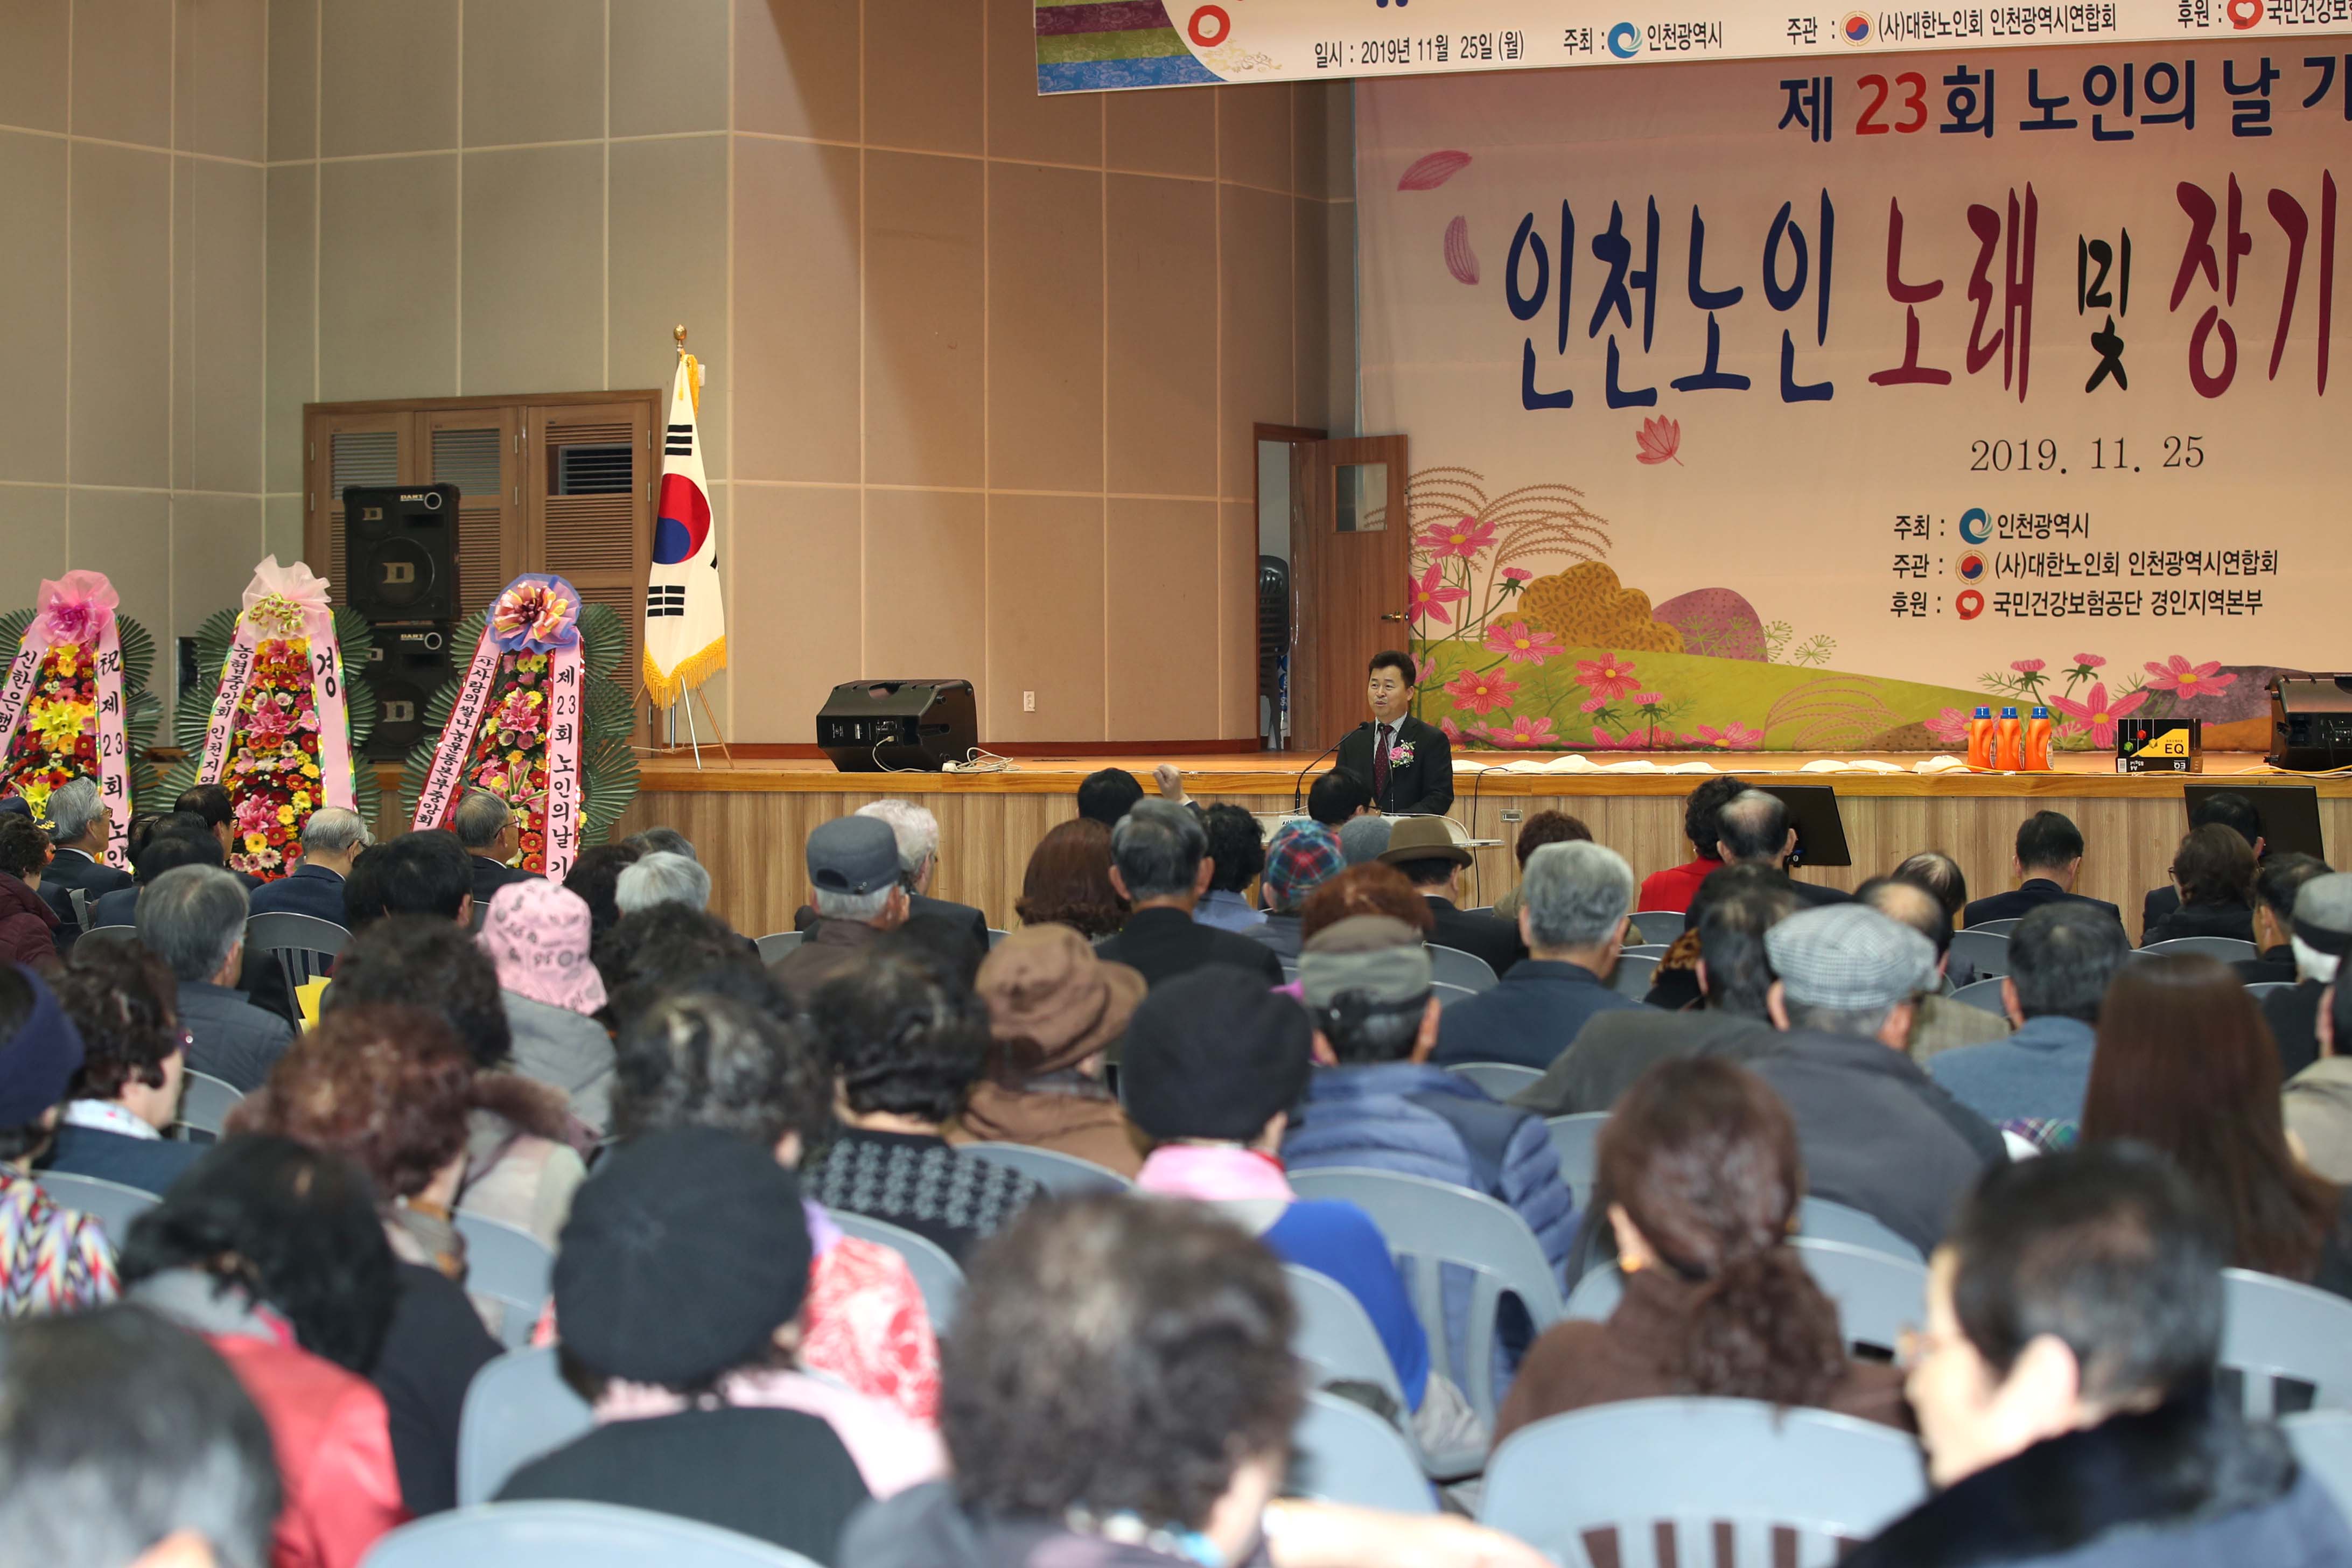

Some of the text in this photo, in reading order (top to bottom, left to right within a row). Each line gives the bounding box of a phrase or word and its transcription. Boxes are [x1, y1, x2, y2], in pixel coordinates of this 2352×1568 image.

[1786, 17, 1818, 45] 주관
[1879, 8, 1983, 43] (사)대한노인회
[1990, 3, 2117, 36] 인천광역시연합회
[2178, 0, 2210, 28] 후원
[2267, 0, 2352, 25] 국민건강보
[1314, 40, 1342, 68] 일시
[1361, 37, 1410, 64] 2019년
[1418, 34, 1448, 62] 11월
[1460, 32, 1492, 60] 25일
[1499, 30, 1524, 61] (월)
[1563, 27, 1593, 55] 주최
[1647, 20, 1723, 52] 인천광역시
[2019, 61, 2195, 142] 노인의
[2223, 57, 2281, 137] 날
[1506, 169, 2337, 410] 인천노인 노래 및 장기
[2162, 435, 2205, 467] 25
[1893, 514, 1930, 540] 주최
[1997, 512, 2089, 539] 인천광역시
[1892, 552, 1929, 579] 주관
[1995, 550, 2120, 579] (사)대한노인회
[2128, 549, 2278, 577] 인천광역시연합회
[1891, 591, 1928, 618] 후원
[1992, 589, 2143, 618] 국민건강보험공단
[2151, 589, 2263, 616] 경인지역본부
[2165, 743, 2185, 755] EQ
